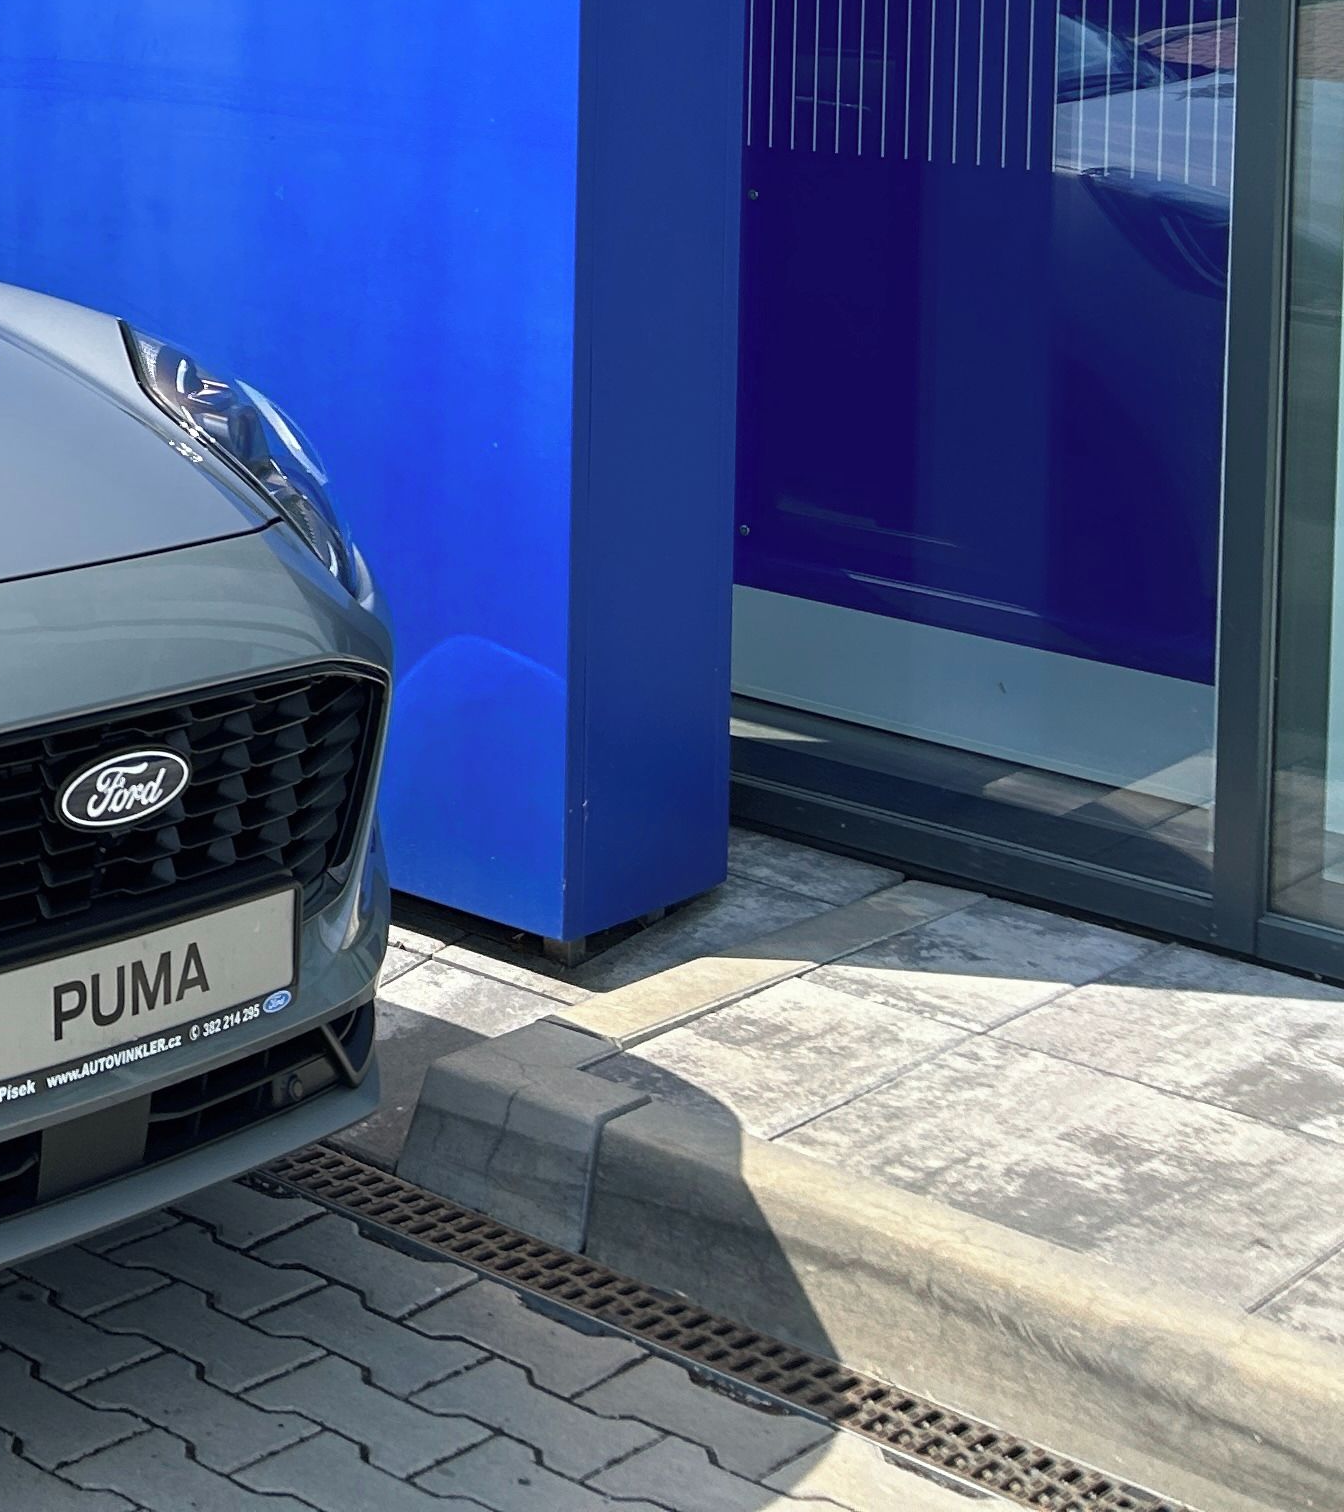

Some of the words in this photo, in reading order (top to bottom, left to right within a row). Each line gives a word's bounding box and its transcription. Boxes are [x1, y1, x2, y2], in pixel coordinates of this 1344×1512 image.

[87, 762, 166, 817] Ford
[53, 942, 210, 1041] PUMA
[46, 1035, 182, 1089] www.AUTOVINKLER.cz
[202, 1018, 222, 1037] 382
[222, 1011, 241, 1030] 214
